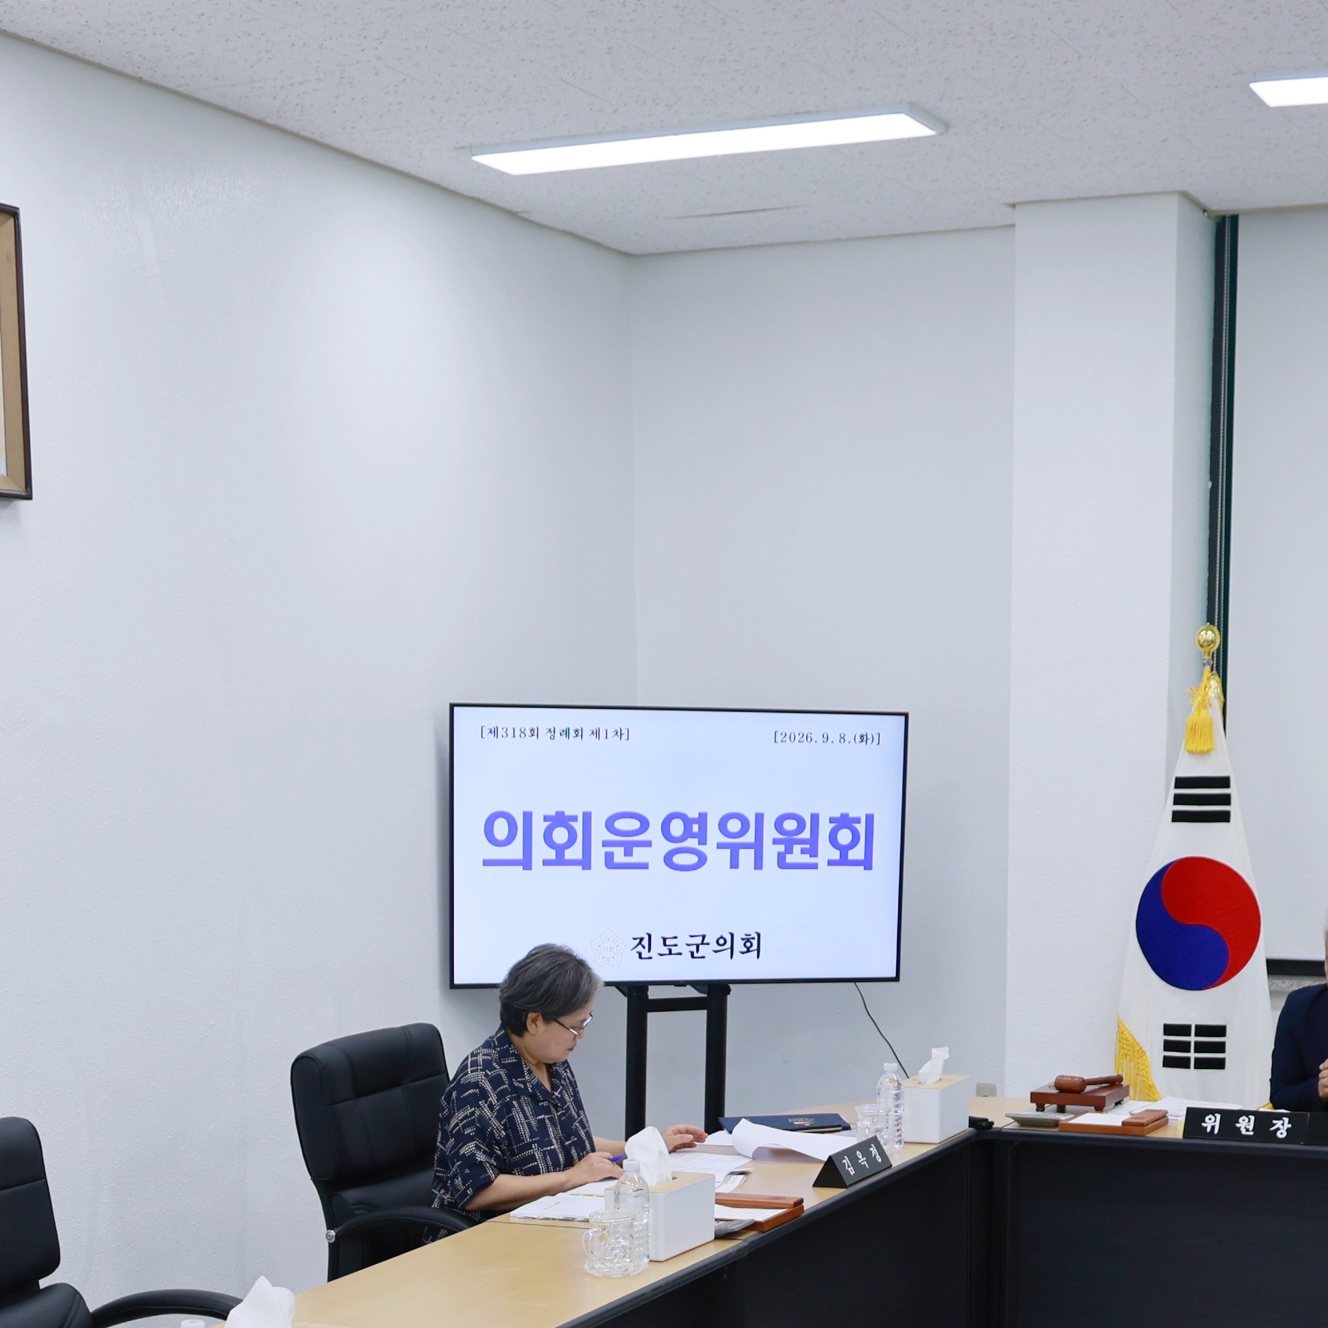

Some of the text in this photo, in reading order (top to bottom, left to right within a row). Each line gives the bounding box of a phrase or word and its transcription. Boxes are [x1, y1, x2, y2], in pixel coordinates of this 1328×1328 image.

[480, 725, 630, 741] [제318회 정례회 제1차]
[482, 810, 875, 872] 의회운영위원회
[630, 931, 762, 960] 진도군의회
[1201, 1113, 1292, 1138] 위원장
